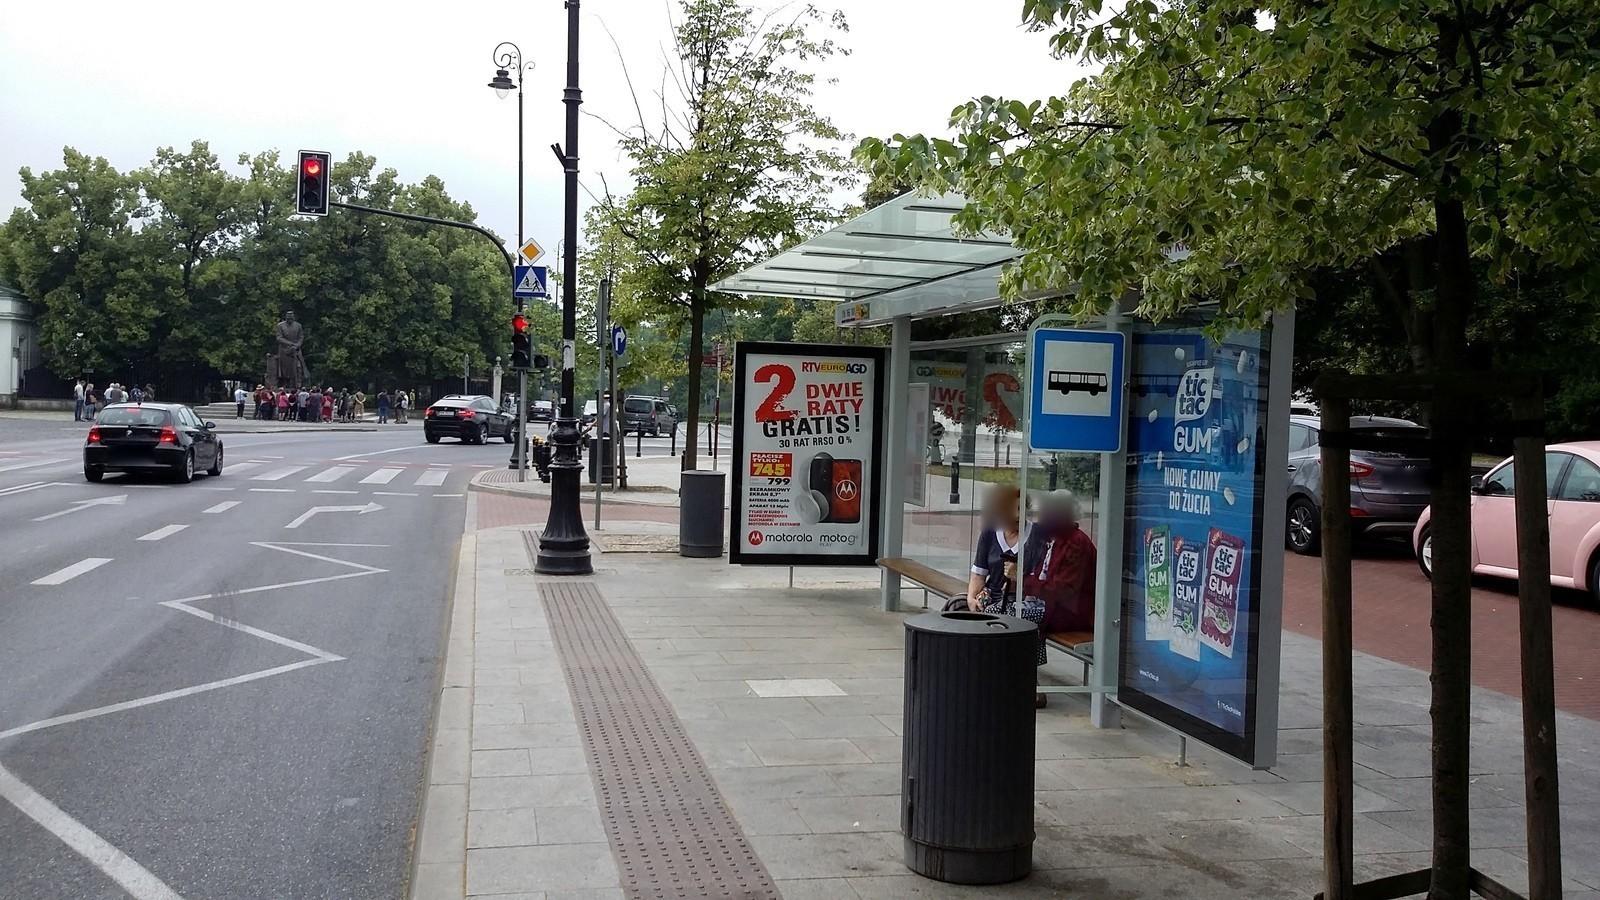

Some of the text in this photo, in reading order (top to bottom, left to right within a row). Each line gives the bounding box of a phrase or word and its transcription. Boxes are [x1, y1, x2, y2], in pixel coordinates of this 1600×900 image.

[754, 364, 800, 423] 2
[806, 382, 863, 399] DWIE
[1185, 373, 1207, 397] tic
[808, 399, 864, 416] RATY
[1179, 394, 1205, 415] tac
[779, 440, 790, 448] 30
[793, 438, 810, 447] RAT
[813, 436, 834, 446] RRSO
[1174, 426, 1212, 454] GUM
[753, 463, 785, 476] 745
[768, 477, 790, 486] 799
[1164, 467, 1220, 492] NOWE GUMY
[1169, 489, 1210, 515] DO ŻUCIA
[765, 533, 812, 542] motorola
[1153, 540, 1163, 553] tic
[1151, 552, 1163, 565] tac
[1183, 553, 1195, 568] tic
[1219, 547, 1232, 565] tic
[1179, 564, 1194, 579] tac
[1215, 557, 1231, 575] tac
[1149, 571, 1167, 587] GUM
[1209, 575, 1233, 600] GUM
[1176, 583, 1197, 603] GUM
